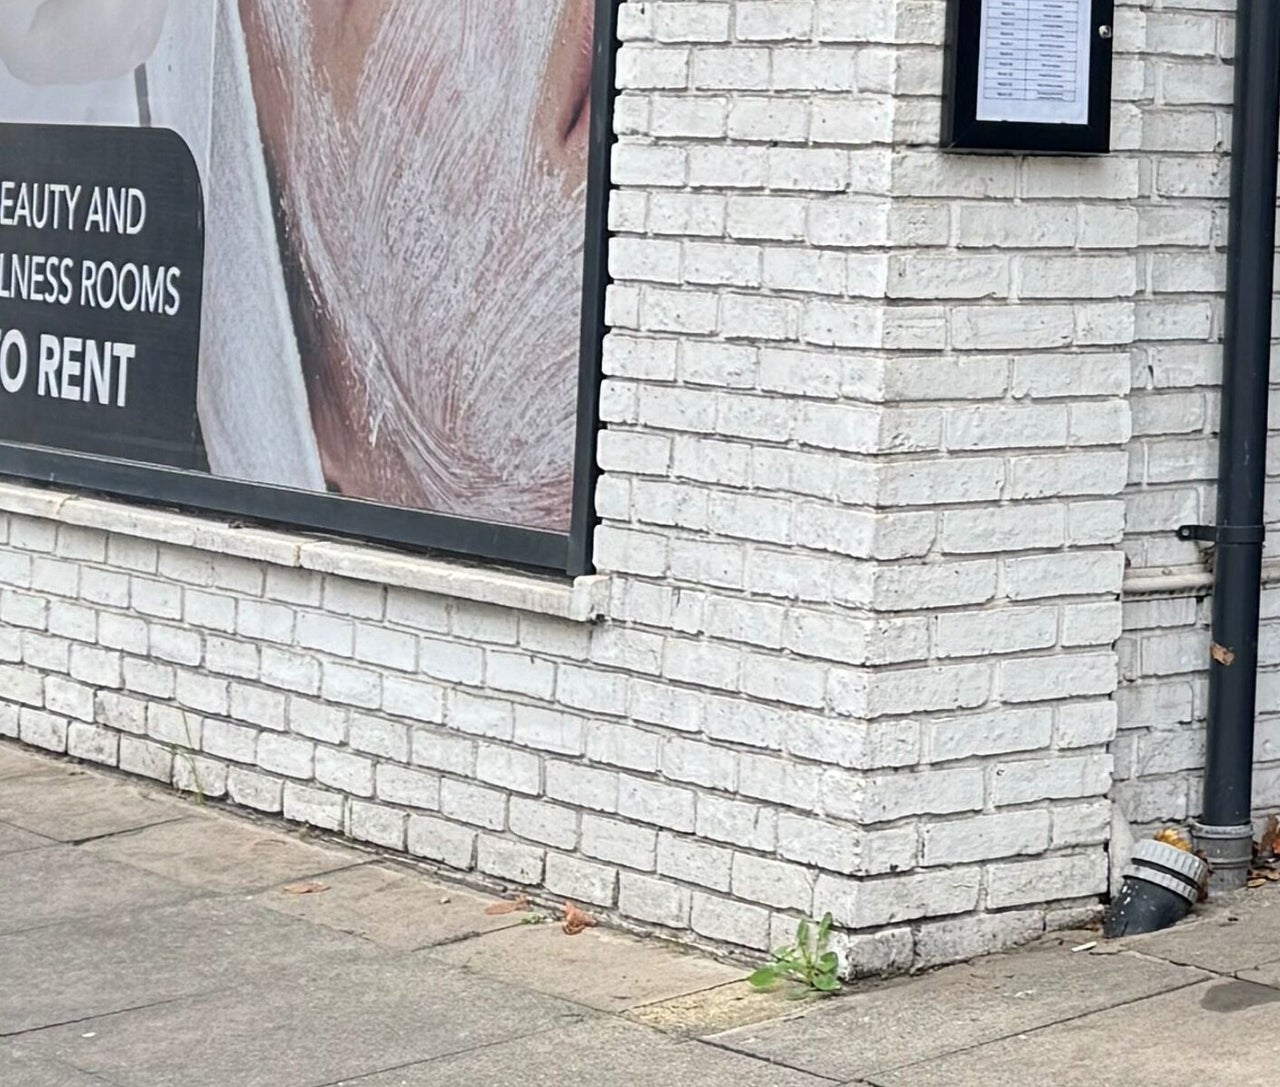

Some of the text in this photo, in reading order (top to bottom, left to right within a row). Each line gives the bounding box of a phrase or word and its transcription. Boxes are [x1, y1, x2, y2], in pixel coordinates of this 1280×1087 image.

[0, 180, 146, 235] EAUTY AND
[81, 260, 181, 316] ROOMS
[0, 328, 136, 407] O RENT
